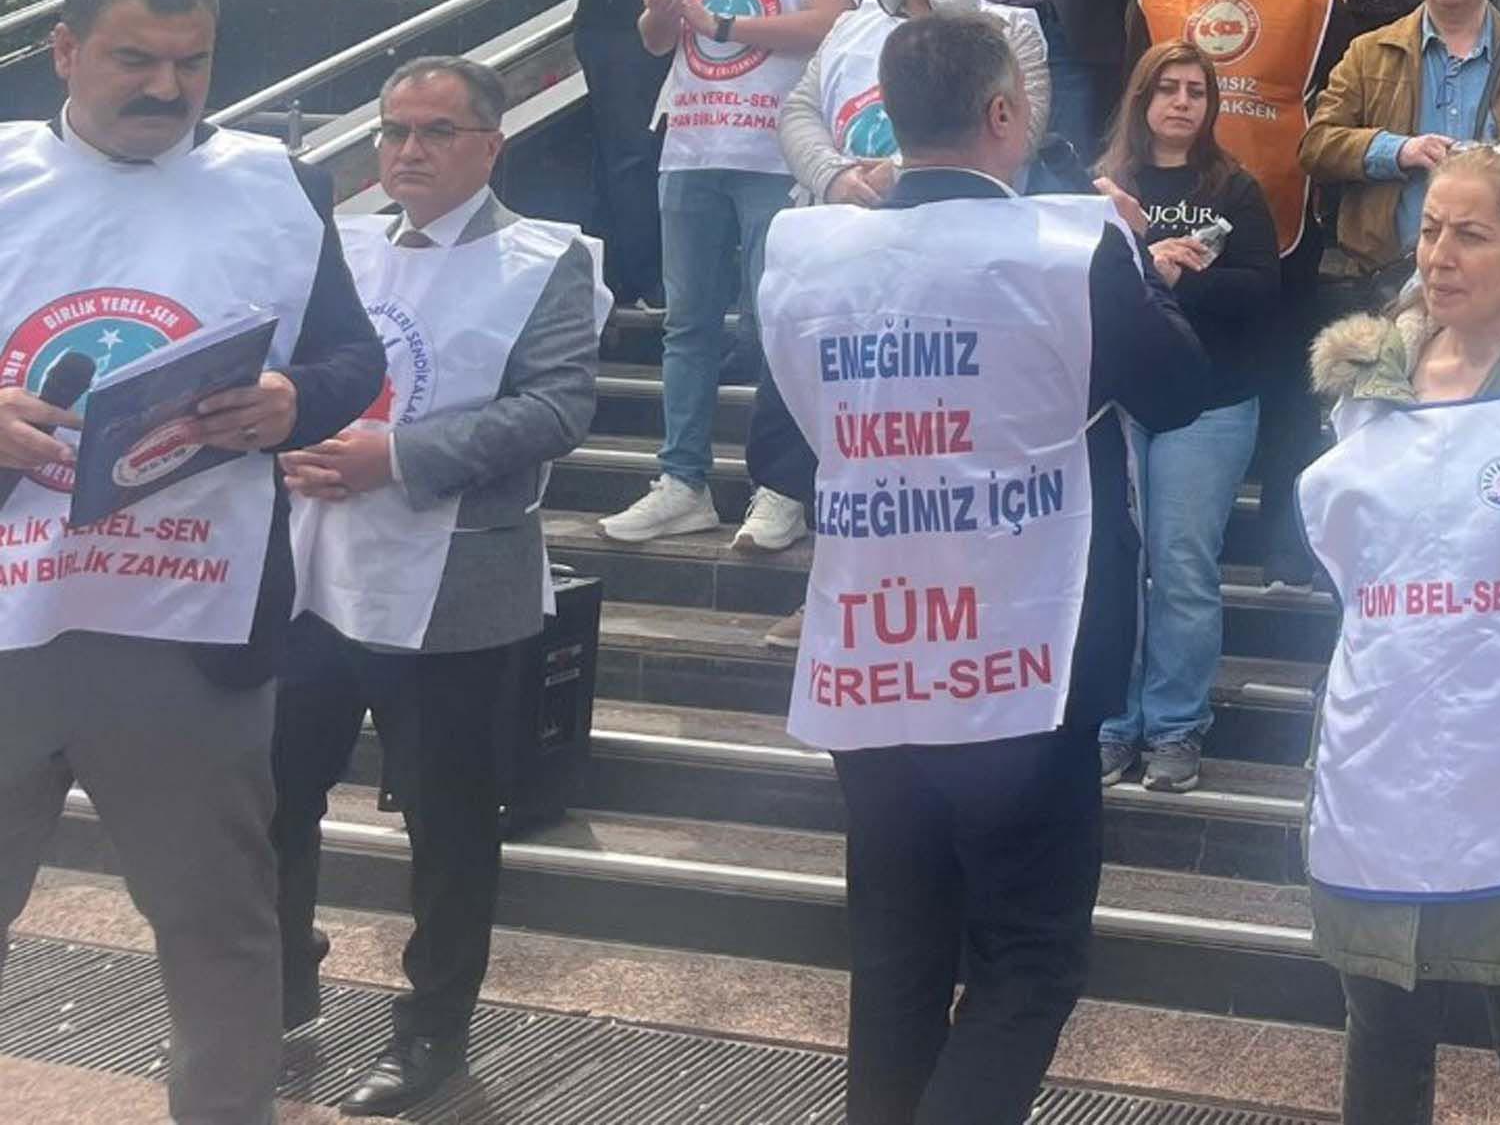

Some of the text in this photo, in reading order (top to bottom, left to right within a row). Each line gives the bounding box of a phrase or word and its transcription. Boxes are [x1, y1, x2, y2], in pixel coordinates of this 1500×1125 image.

[1216, 75, 1257, 93] MSIZ
[1219, 99, 1277, 122] AKSEN
[101, 295, 181, 328] YEREL-SEN
[817, 465, 1064, 539] LECEĞİMİZ İÇİN
[0, 515, 51, 547] LİK
[0, 558, 28, 586] AN
[117, 553, 229, 583] ZAMANI
[838, 576, 978, 649] TÜM
[811, 643, 1053, 707] YEREL-SEN
